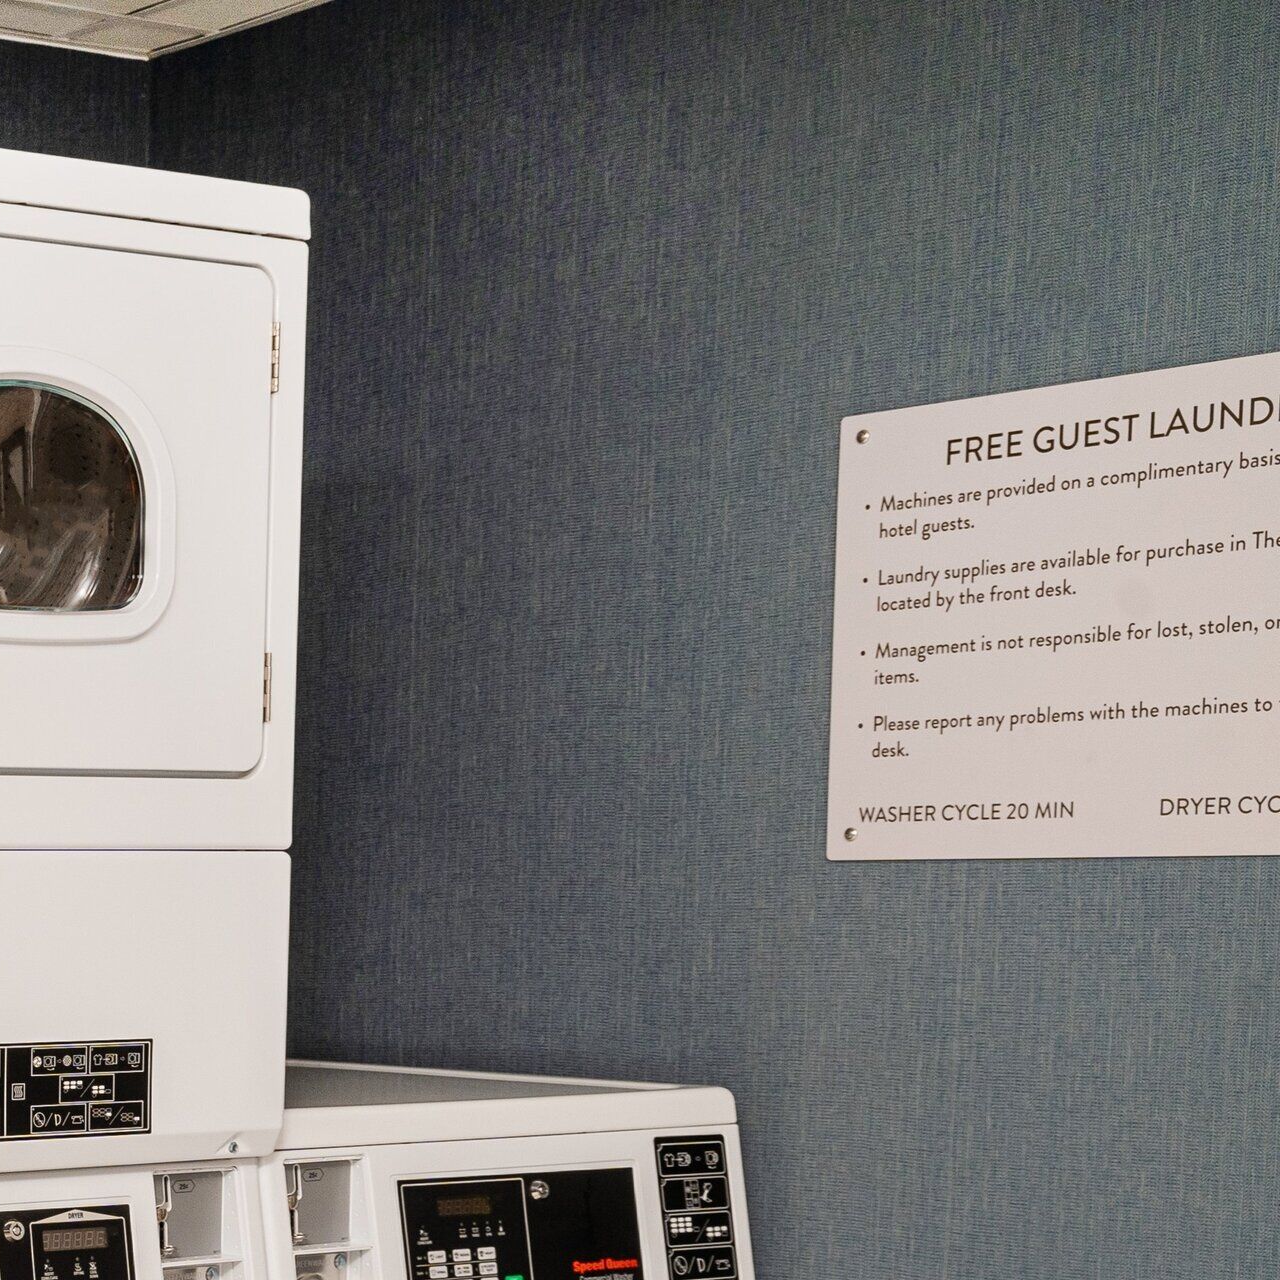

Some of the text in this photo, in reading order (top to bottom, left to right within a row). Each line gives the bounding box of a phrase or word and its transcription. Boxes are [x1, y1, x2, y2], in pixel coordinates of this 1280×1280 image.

[947, 397, 1280, 465] FREE GUEST LAUND
[881, 492, 953, 512] Machines
[958, 491, 981, 503] are
[987, 475, 1055, 506] provided
[1061, 479, 1080, 490] on
[1087, 477, 1094, 487] a
[1101, 460, 1233, 488] complimentary
[880, 517, 974, 540] hotel guests.
[879, 566, 939, 587] Laundry
[945, 559, 1005, 584] supplies
[1011, 561, 1035, 572] are
[1041, 548, 1110, 570] available
[1116, 545, 1140, 562] for
[1146, 539, 1224, 566] purchase
[1231, 535, 1245, 551] in
[877, 579, 1076, 612] located by the front desk.
[876, 640, 975, 662] Management
[982, 635, 992, 651] is
[998, 636, 1023, 649] not
[1030, 625, 1121, 652] responsible
[1127, 623, 1152, 640] for
[1158, 621, 1192, 639] lost,
[1199, 615, 1258, 635] stolen,
[875, 670, 919, 685] items.
[874, 697, 1272, 734] Please report any problems with the machines to
[872, 741, 909, 757] desk.
[859, 802, 1073, 822] WASHER CYCLE 20 MIN
[1160, 797, 1231, 816] DRYER
[572, 1258, 638, 1274] Speed Queen
[614, 1273, 634, 1280] Washer
